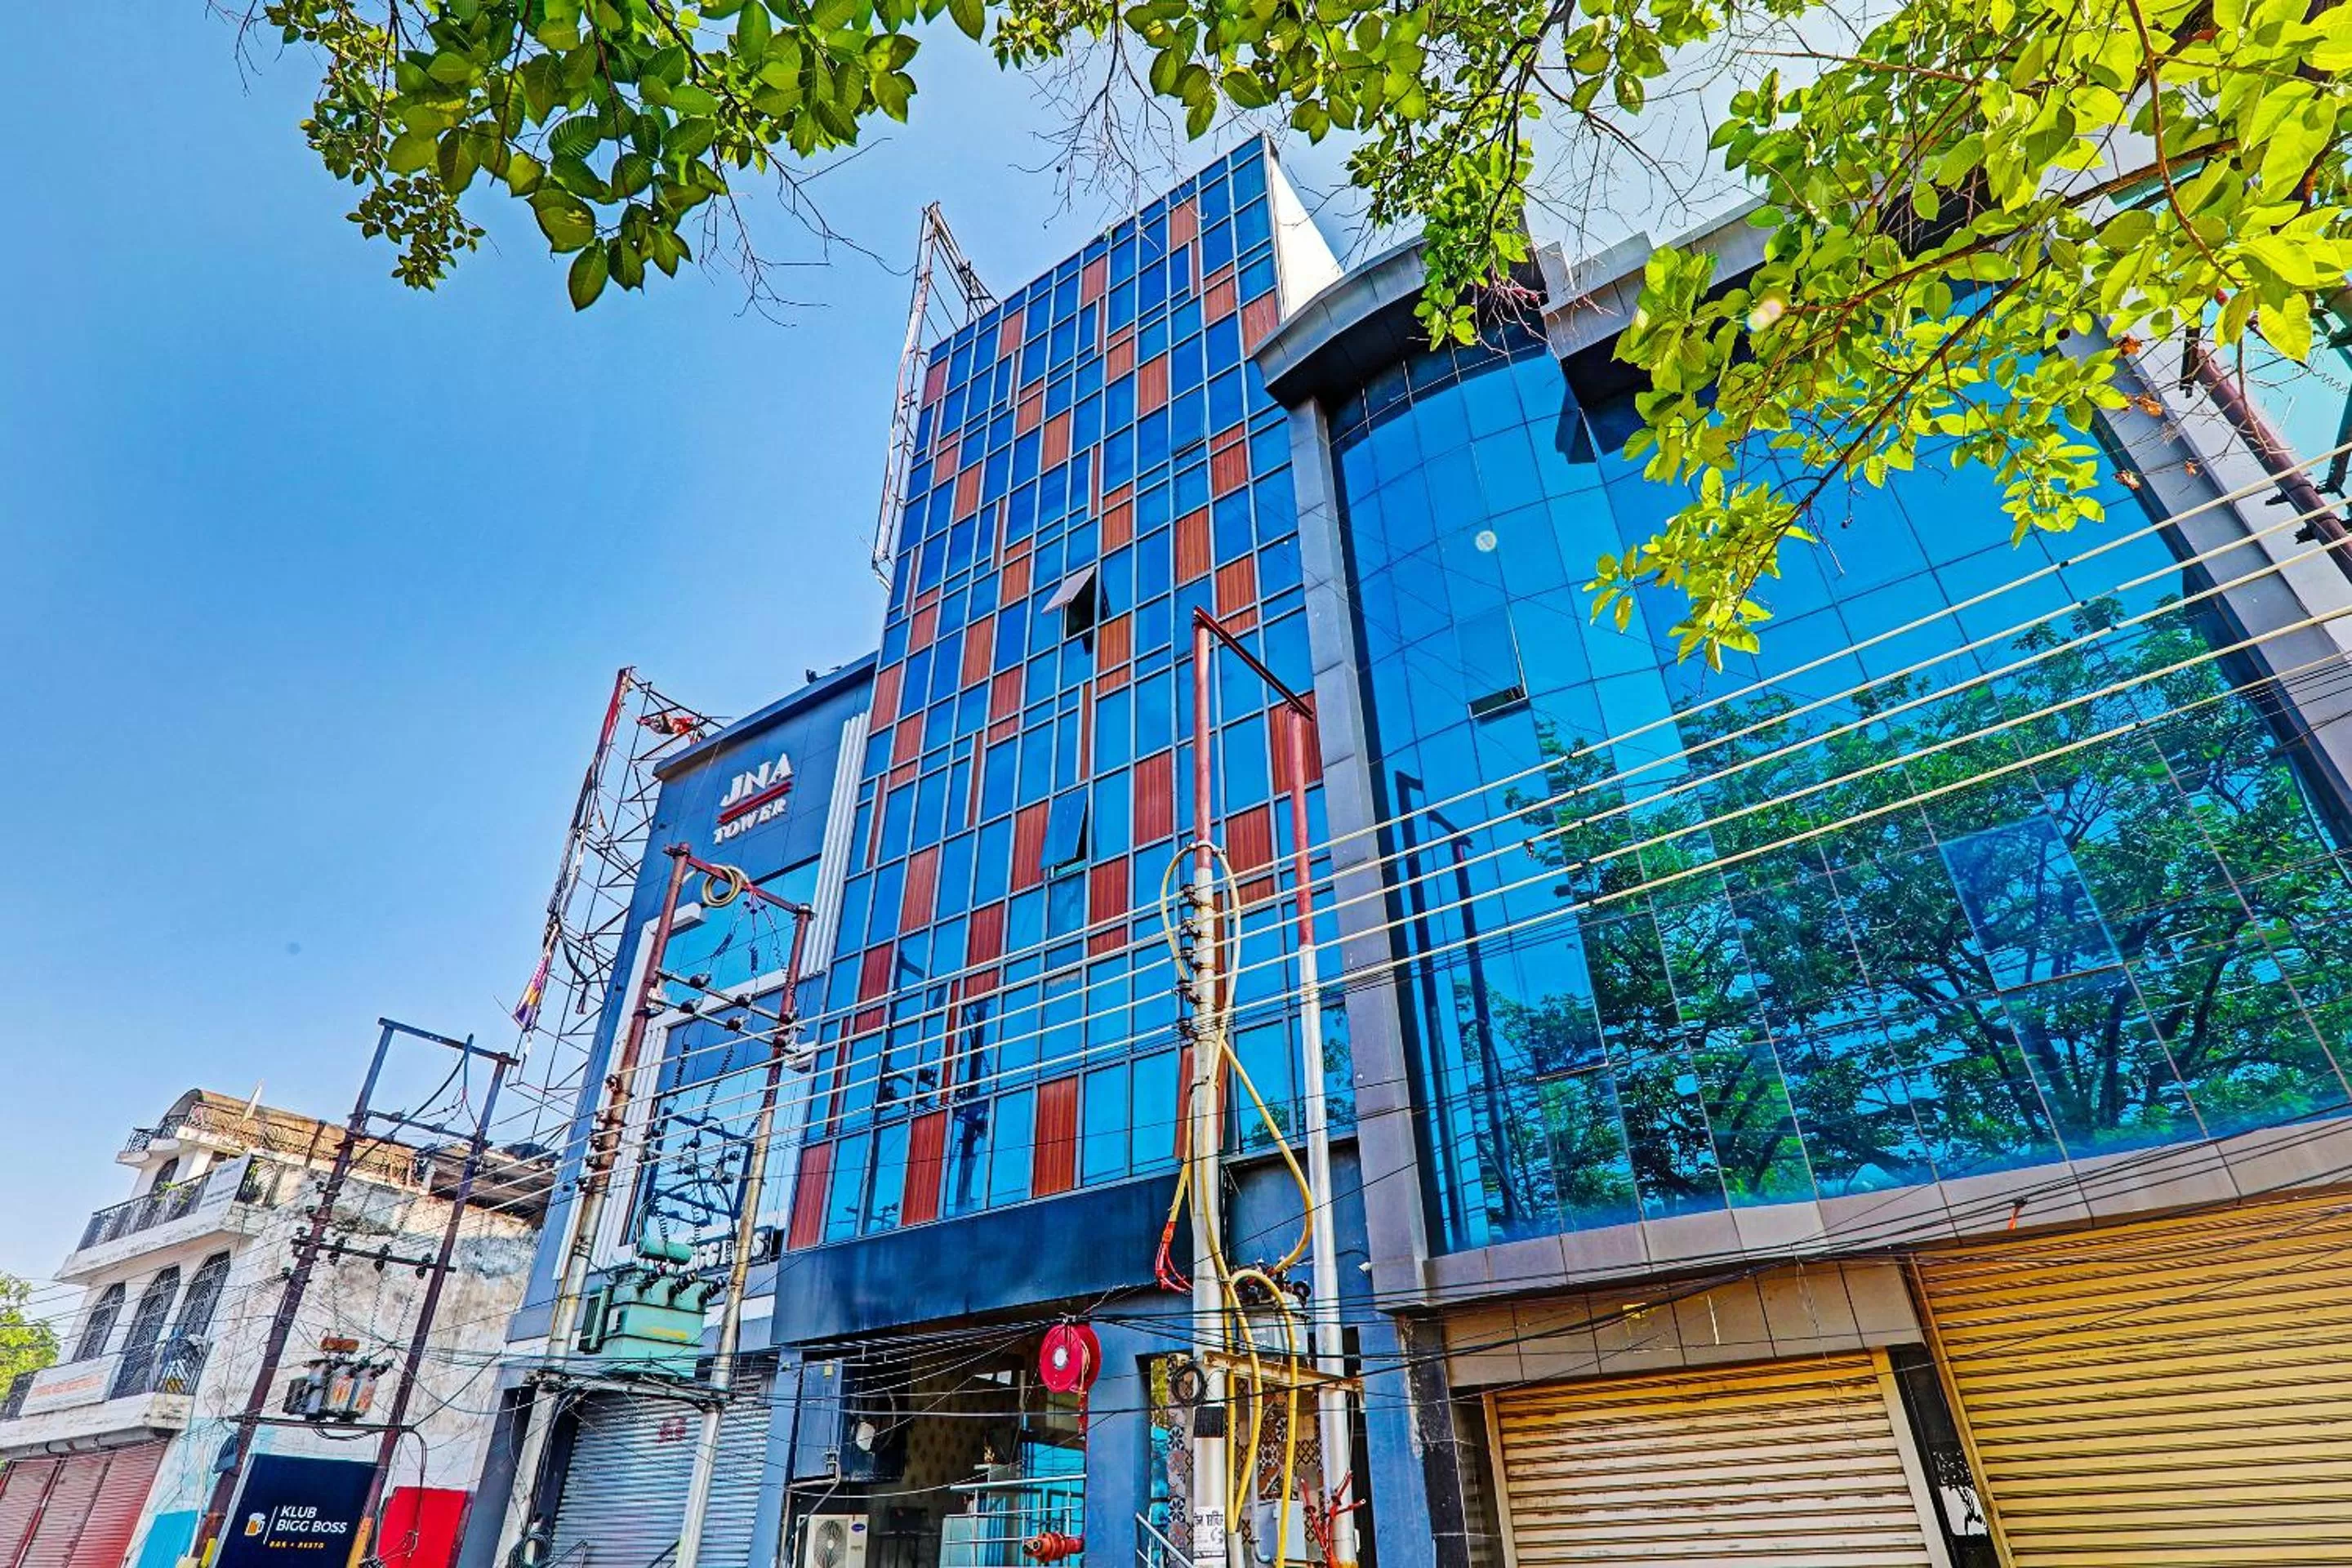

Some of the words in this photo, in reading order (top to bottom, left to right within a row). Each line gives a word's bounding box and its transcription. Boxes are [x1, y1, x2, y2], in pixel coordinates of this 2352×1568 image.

[719, 752, 793, 807] JNA
[713, 798, 786, 844] TOWER
[275, 1519, 310, 1532] BIGG
[311, 1520, 348, 1534] BOSS
[280, 1505, 318, 1518] KLUB
